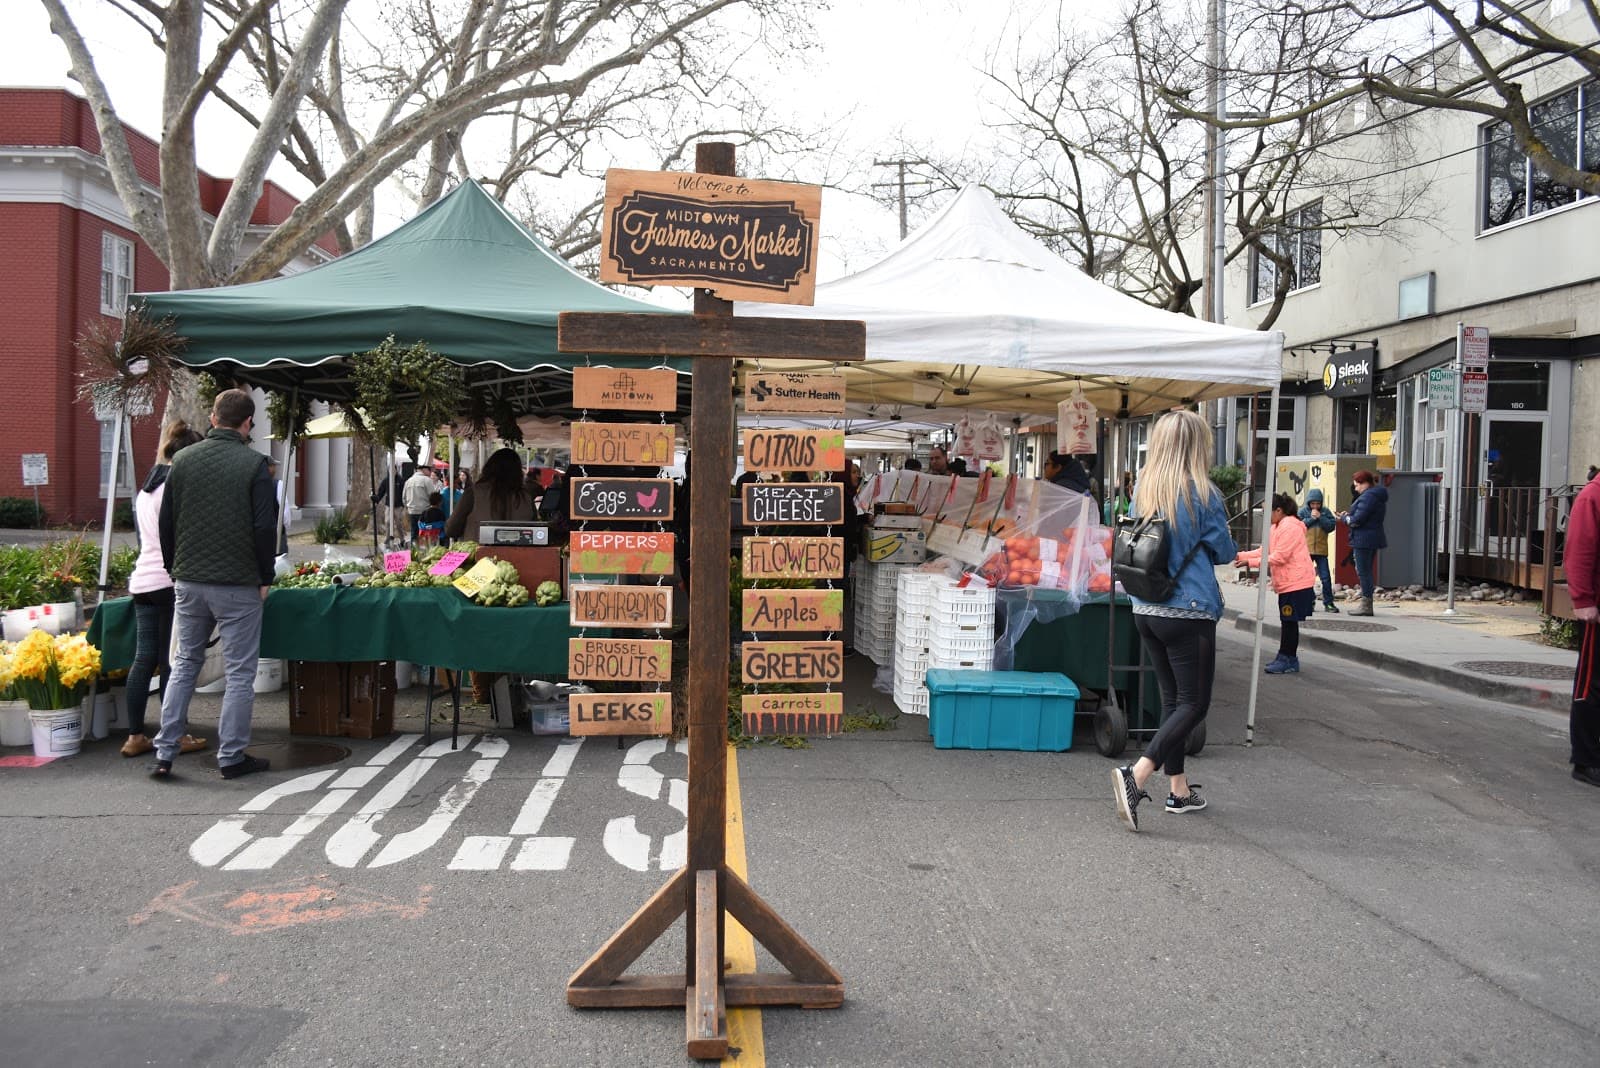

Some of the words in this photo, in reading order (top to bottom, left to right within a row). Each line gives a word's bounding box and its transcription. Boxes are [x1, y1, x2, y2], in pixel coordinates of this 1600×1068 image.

[677, 176, 732, 194] Welcome
[736, 183, 750, 195] to
[666, 209, 740, 225] MIDTOWN
[623, 210, 717, 254] Farmers
[720, 218, 801, 270] Market
[650, 256, 746, 272] SACRAMENTO
[1339, 360, 1368, 378] sleek
[1431, 371, 1441, 380] 90
[601, 392, 653, 401] MIDTOWN
[775, 387, 808, 398] Sutter
[809, 389, 840, 401] Health
[1430, 384, 1453, 392] PARKING
[599, 429, 640, 440] OLIVE
[602, 440, 635, 462] OIL
[750, 433, 816, 468] CITRUS
[753, 487, 819, 498] MEAT
[754, 498, 825, 521] CHEESE
[580, 534, 658, 549] PEPPERS
[750, 541, 840, 573] FLOWERS
[575, 591, 666, 622] MUSHROOMS
[751, 596, 818, 629] Apples
[586, 642, 646, 654] BRUSSEL
[574, 653, 660, 678] SPROUTS
[746, 652, 840, 680] GREENS
[762, 697, 821, 709] carrots
[577, 703, 653, 722] LEEKS
